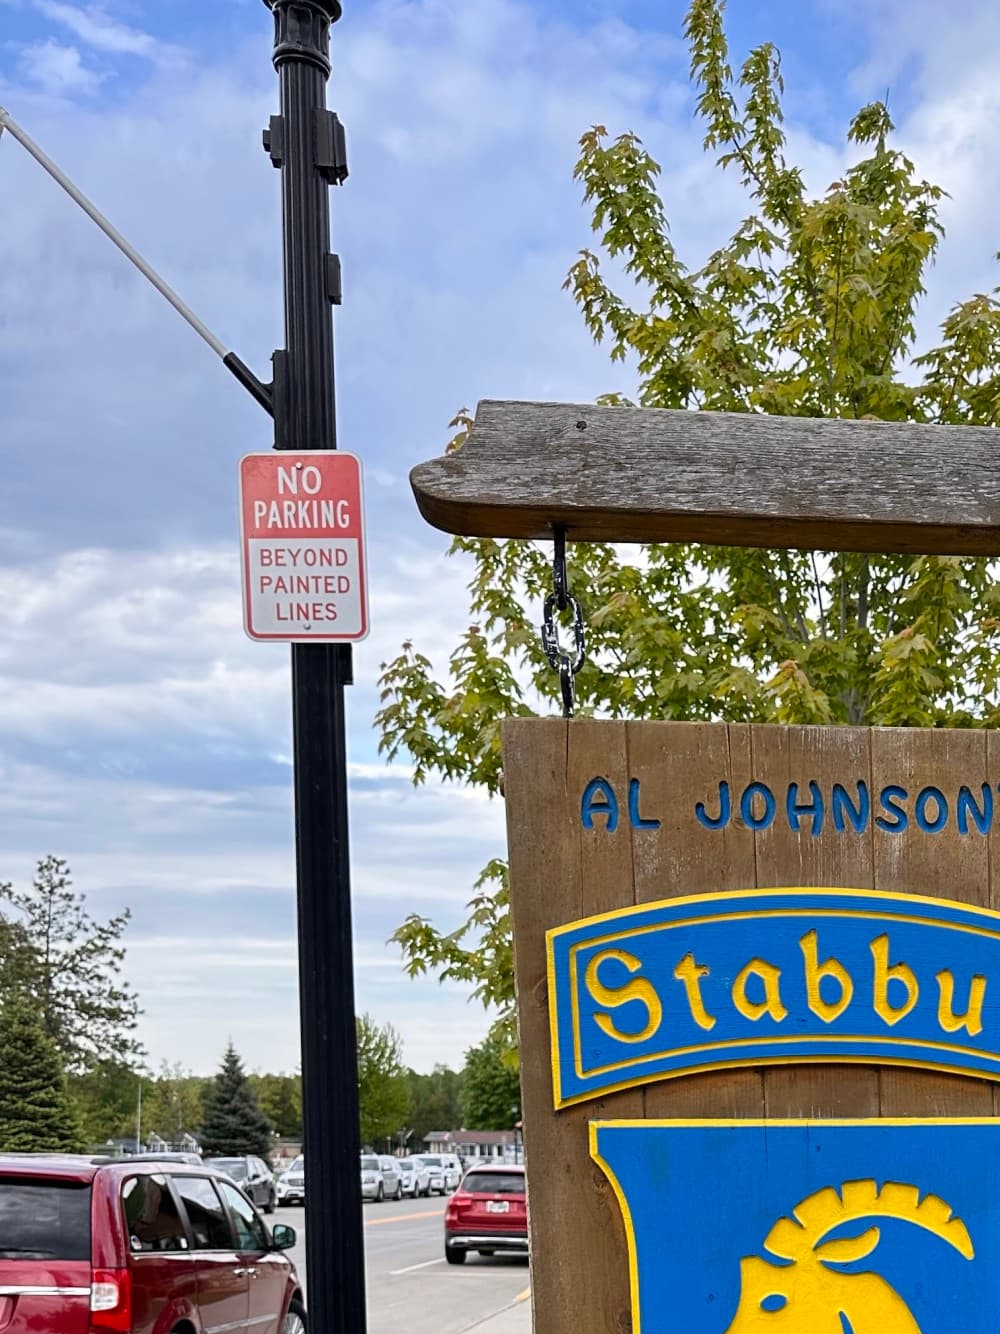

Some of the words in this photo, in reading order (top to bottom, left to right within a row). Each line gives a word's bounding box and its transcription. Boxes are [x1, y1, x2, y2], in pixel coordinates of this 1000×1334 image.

[277, 466, 322, 495] NO
[254, 500, 351, 529] PARKING
[260, 548, 348, 567] BEYOND
[260, 576, 351, 594] PAINTED
[276, 603, 338, 621] LINES
[580, 775, 661, 833] AL
